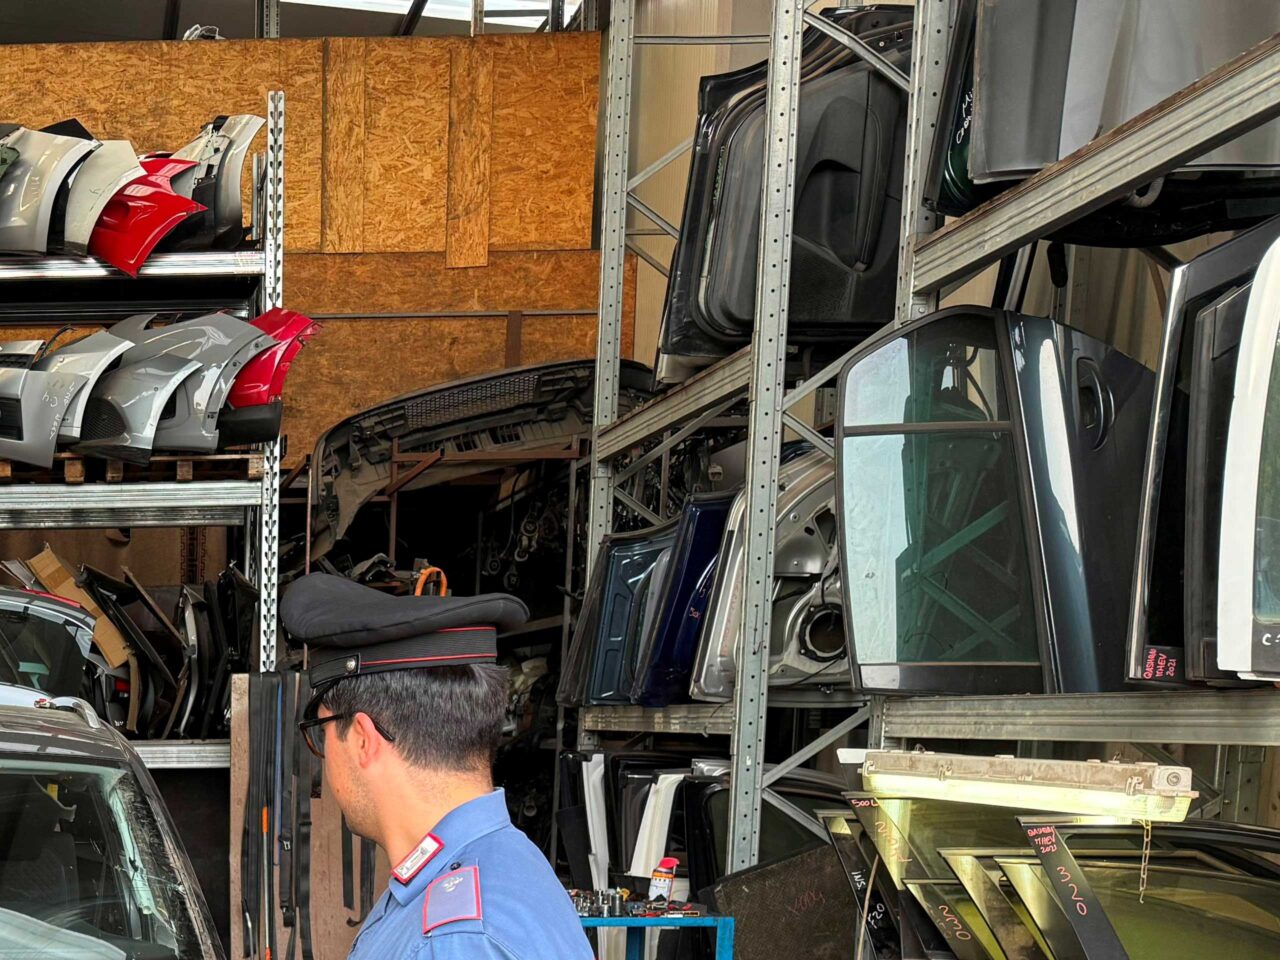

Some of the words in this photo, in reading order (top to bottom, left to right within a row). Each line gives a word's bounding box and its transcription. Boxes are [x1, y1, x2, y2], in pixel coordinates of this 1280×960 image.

[1261, 633, 1280, 646] C
[1166, 658, 1177, 677] 2021
[851, 798, 880, 808] 500L
